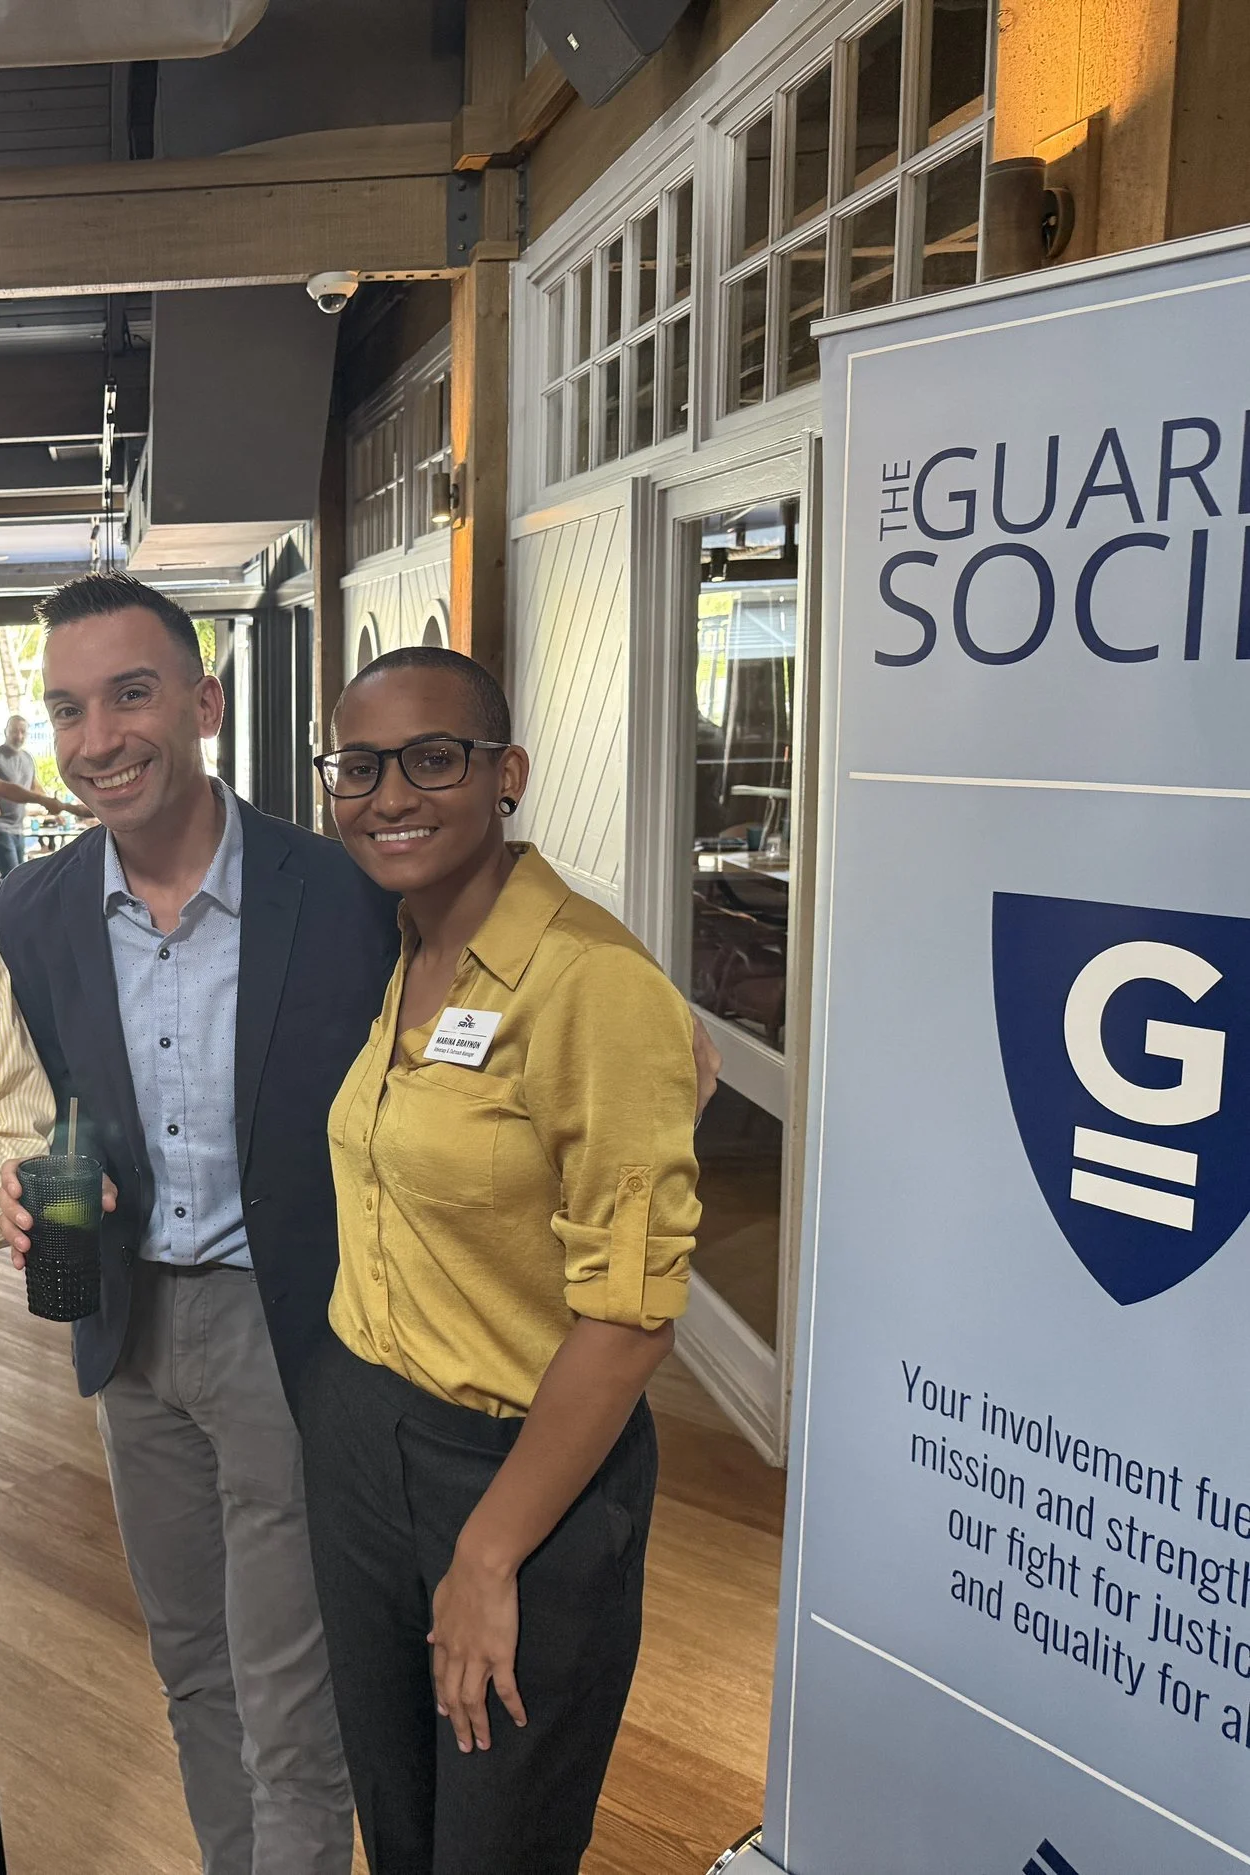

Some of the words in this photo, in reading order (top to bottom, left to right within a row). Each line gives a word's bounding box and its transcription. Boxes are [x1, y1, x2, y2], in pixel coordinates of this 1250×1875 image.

[879, 459, 911, 541] THE
[913, 409, 1250, 541] GUAR
[874, 525, 1250, 668] SOCI
[436, 1036, 456, 1046] MARINA
[901, 1360, 972, 1423] Your
[981, 1391, 1183, 1512] involvement
[911, 1433, 1025, 1510] mission
[1036, 1487, 1095, 1541] and
[948, 1509, 997, 1555] our
[1007, 1526, 1081, 1599] fight
[1092, 1565, 1141, 1623] for
[950, 1569, 1003, 1622] and
[1013, 1601, 1146, 1697] equality
[1157, 1662, 1210, 1723] for
